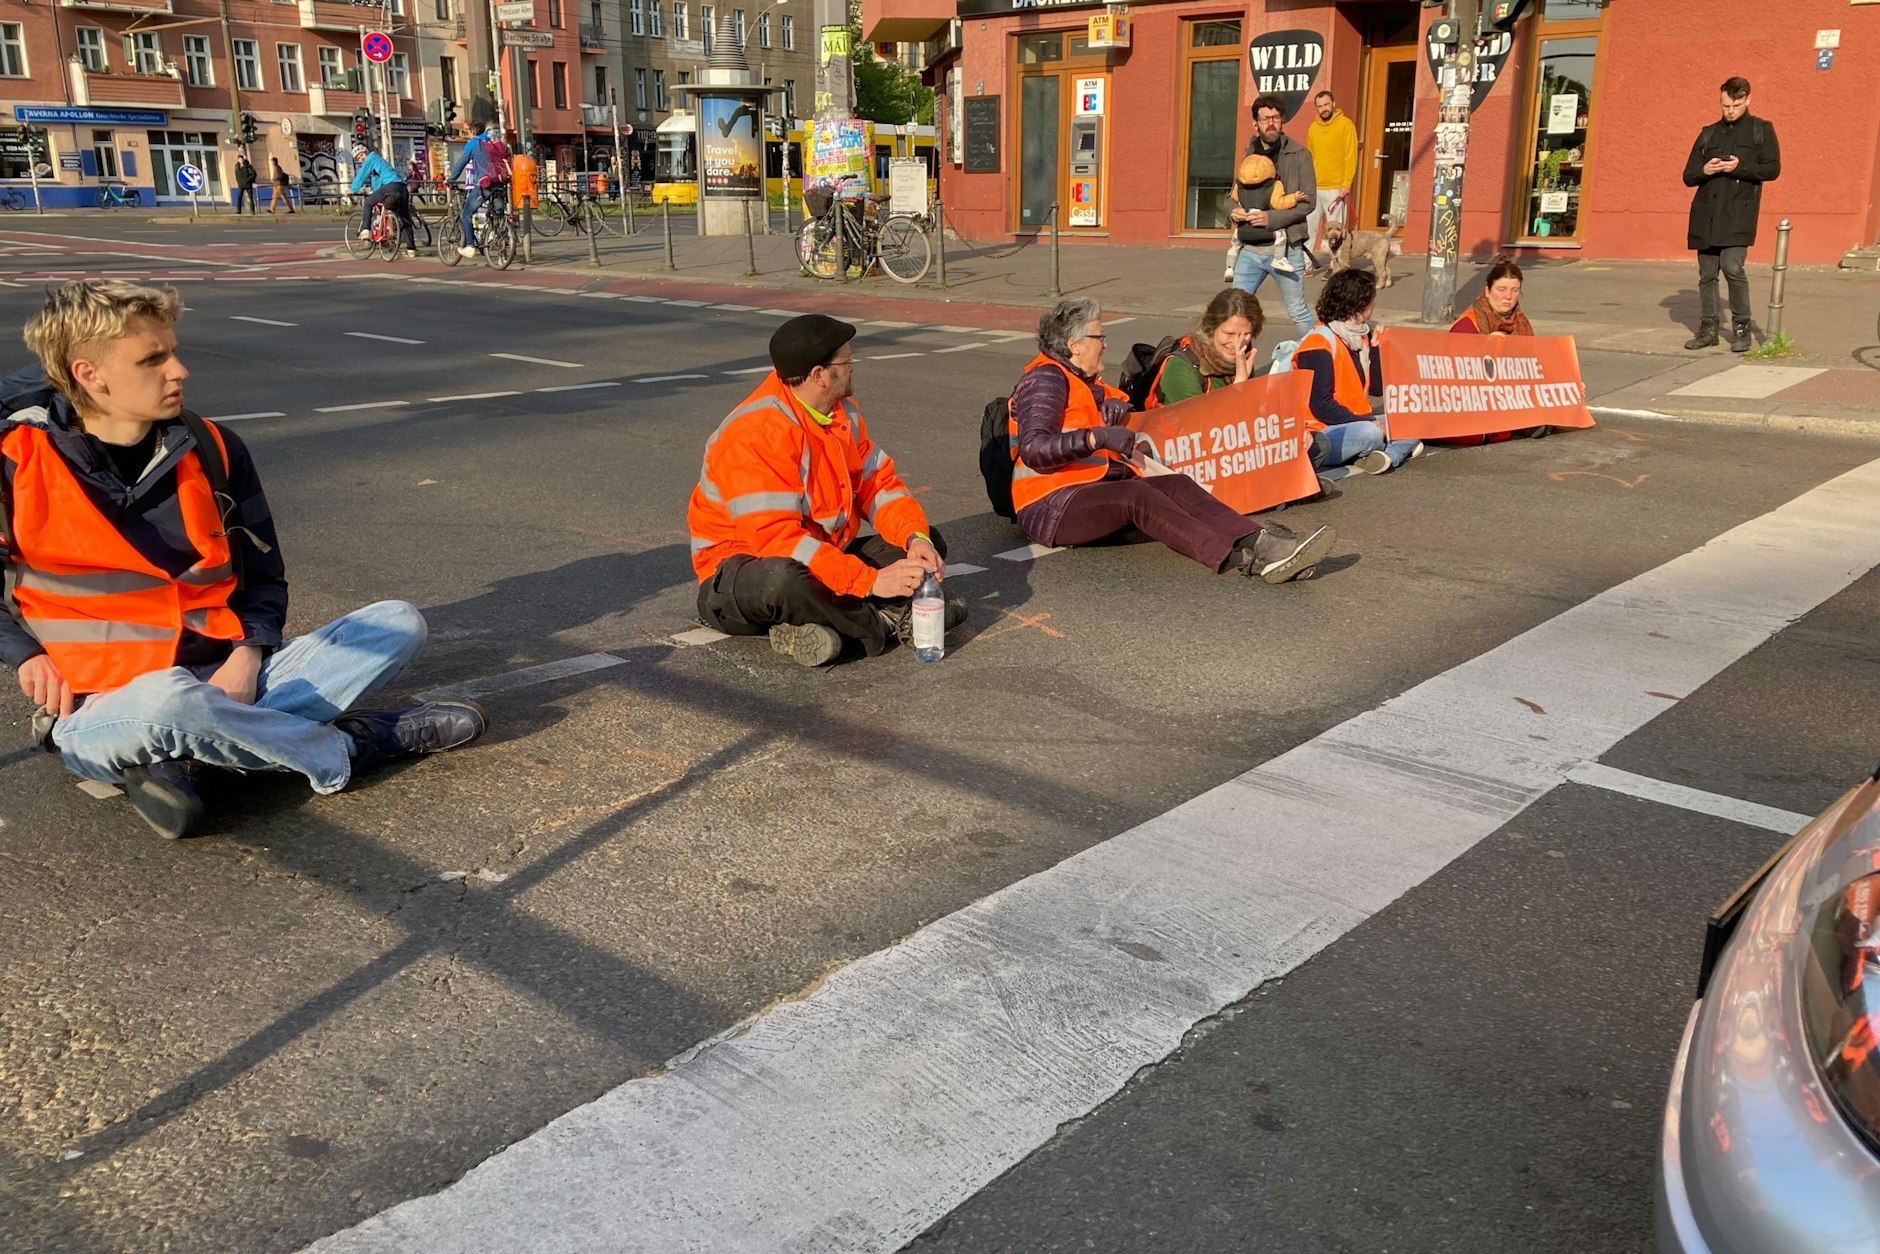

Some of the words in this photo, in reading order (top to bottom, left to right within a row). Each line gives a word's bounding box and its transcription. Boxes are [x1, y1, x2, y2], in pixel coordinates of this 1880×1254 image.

[1093, 16, 1109, 24] ATM
[503, 33, 530, 43] Danziger
[532, 34, 551, 44] Straße
[1250, 43, 1323, 70] WILD
[1259, 73, 1310, 92] HAIR
[705, 145, 738, 155] Travel
[706, 155, 713, 165] if
[715, 157, 735, 168] you
[706, 168, 734, 176] dare.
[1071, 206, 1096, 219] Cash
[1416, 355, 1455, 379] MEHR
[1454, 354, 1545, 383] DEMOKRATIE:
[1385, 384, 1536, 414] GESELLSCHAFTSRAT
[1533, 382, 1582, 408] JETZT!
[1164, 432, 1207, 466] ART.
[1209, 421, 1251, 454] 20A
[1253, 414, 1280, 443] GG
[1220, 438, 1299, 478] SCHÜTZEN
